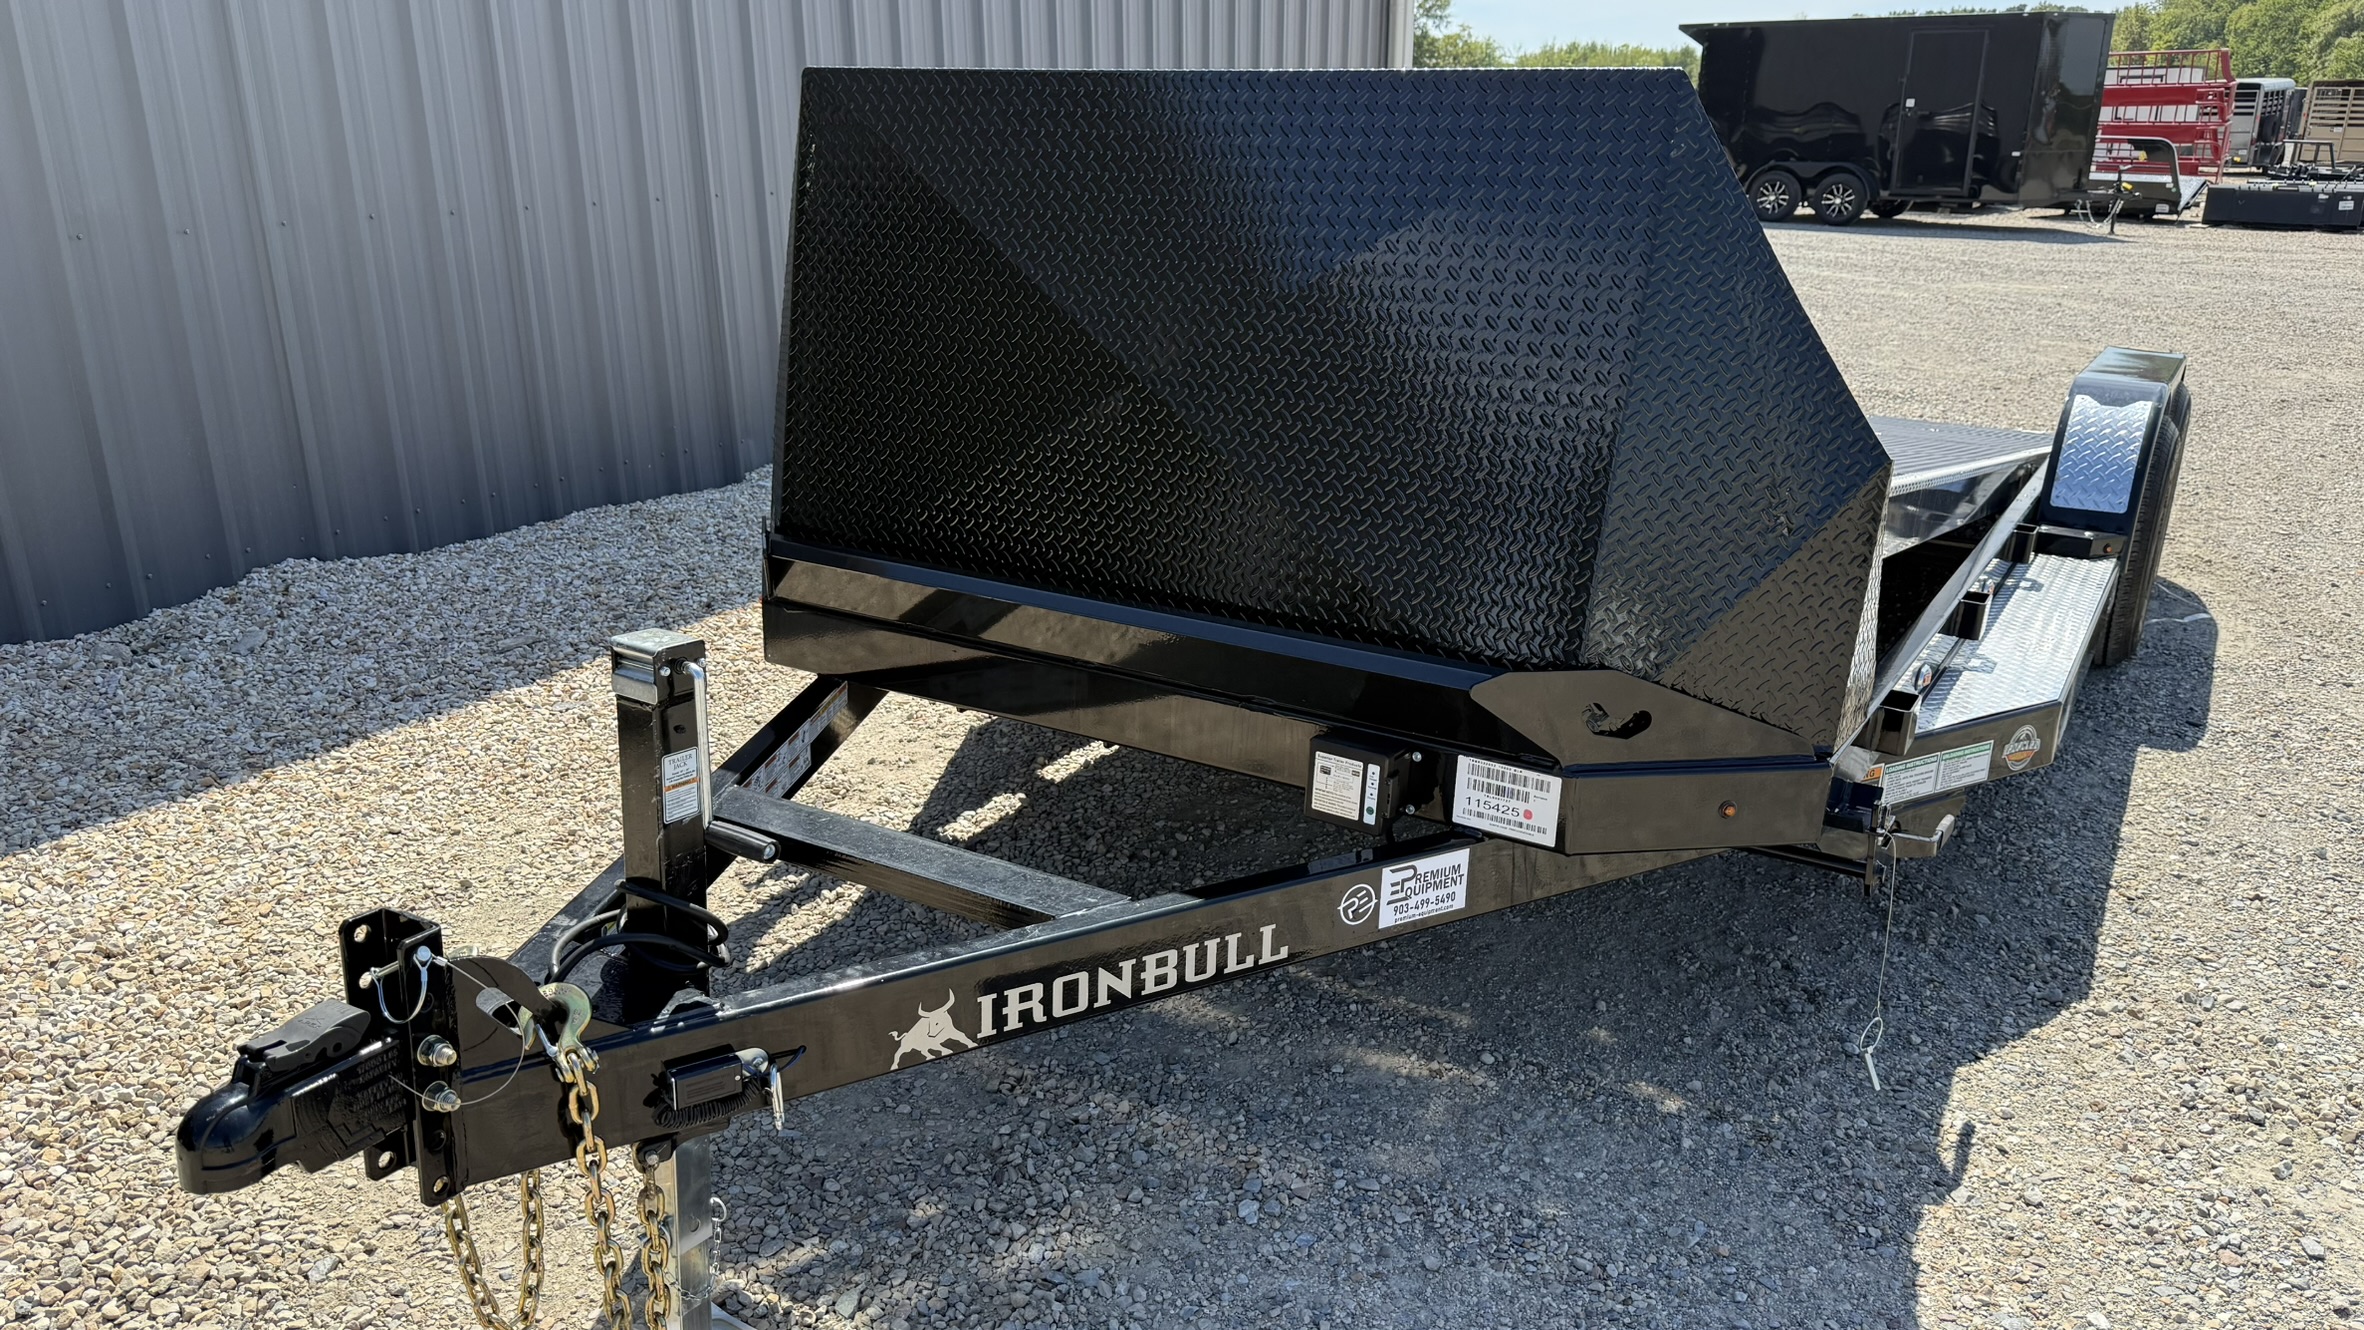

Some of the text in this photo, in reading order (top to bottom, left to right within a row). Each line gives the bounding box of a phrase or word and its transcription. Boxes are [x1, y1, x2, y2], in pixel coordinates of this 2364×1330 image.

[668, 753, 693, 765] TRAILER
[673, 762, 688, 770] JACK
[1885, 762, 1906, 774] LOADING
[1465, 796, 1520, 817] 115425
[1393, 891, 1456, 916] 903-499-5490
[1394, 904, 1454, 923] premium-equipment.com
[976, 923, 1289, 1039] IRONBULL
